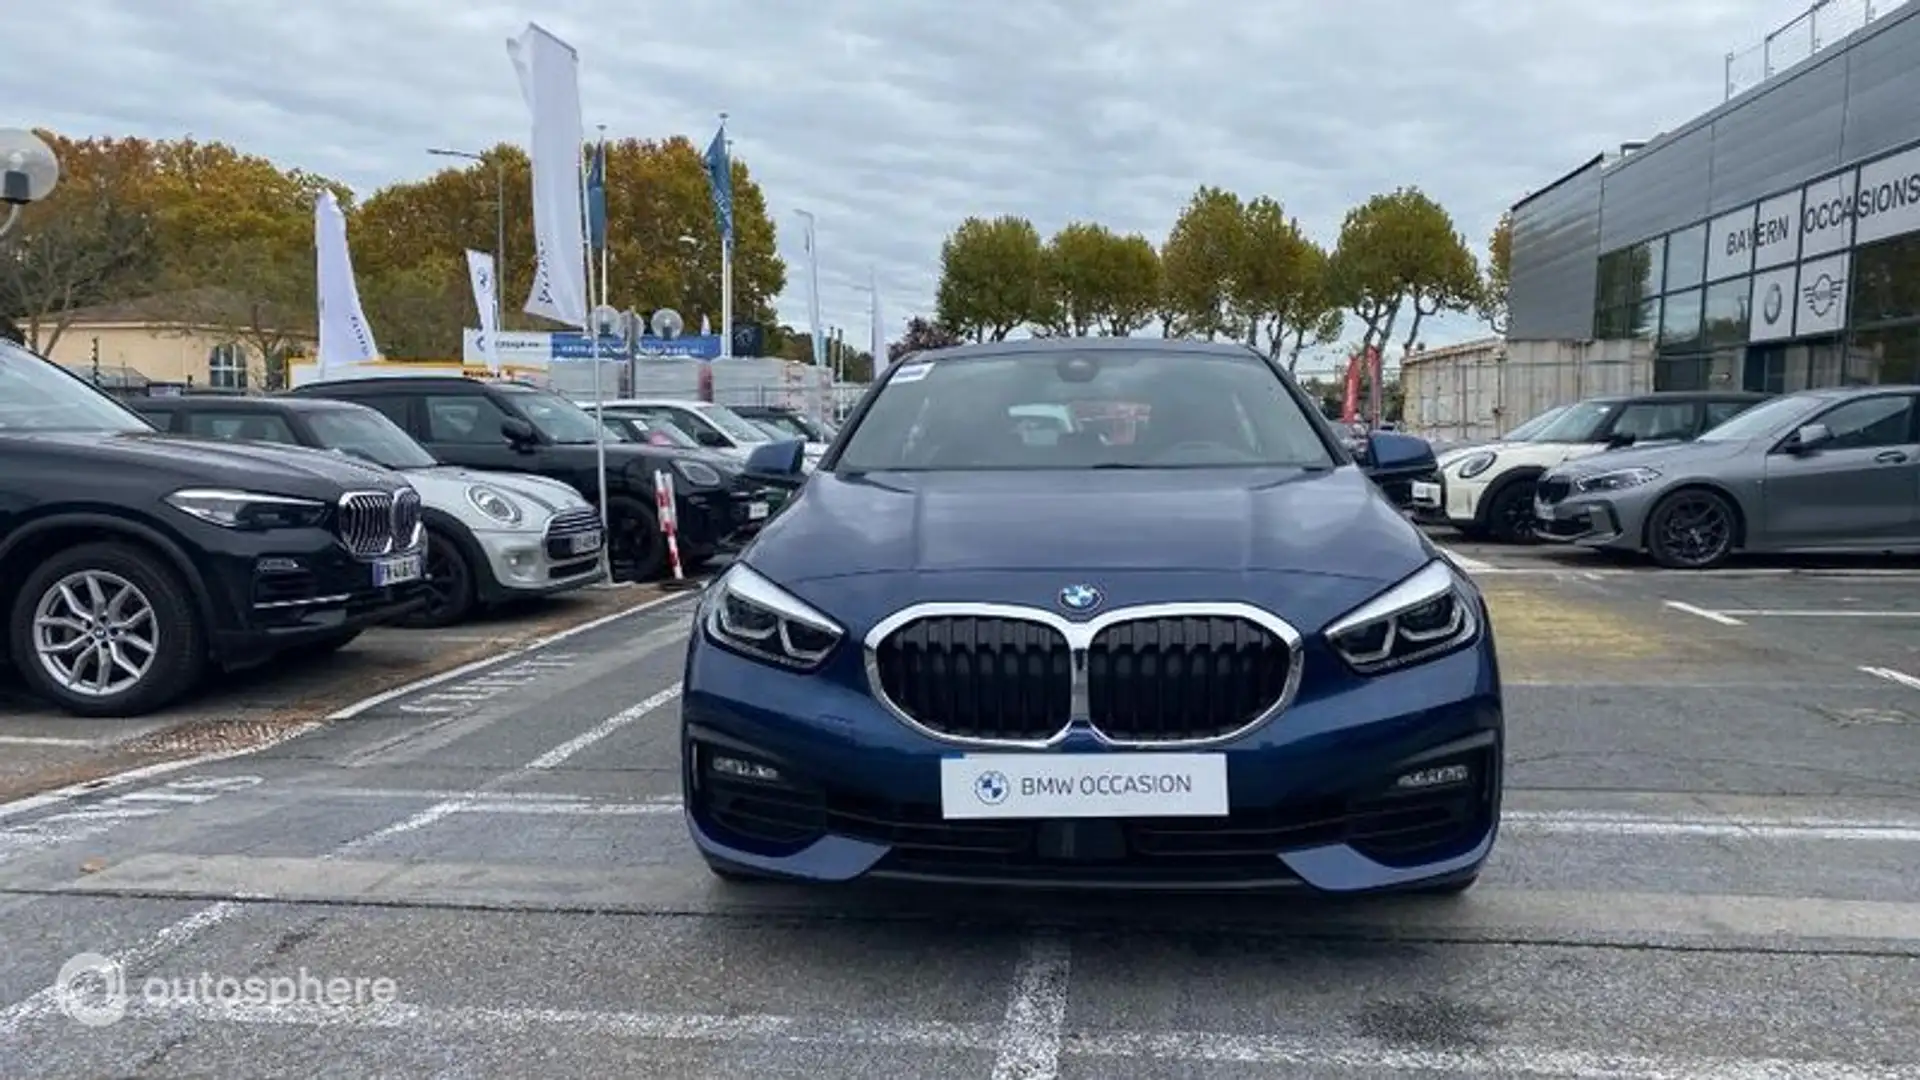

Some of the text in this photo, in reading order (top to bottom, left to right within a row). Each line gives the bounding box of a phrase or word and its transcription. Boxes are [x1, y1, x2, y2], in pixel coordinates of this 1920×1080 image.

[1803, 173, 1920, 233] OCCASIONS
[1021, 774, 1192, 796] BMW OCCASION
